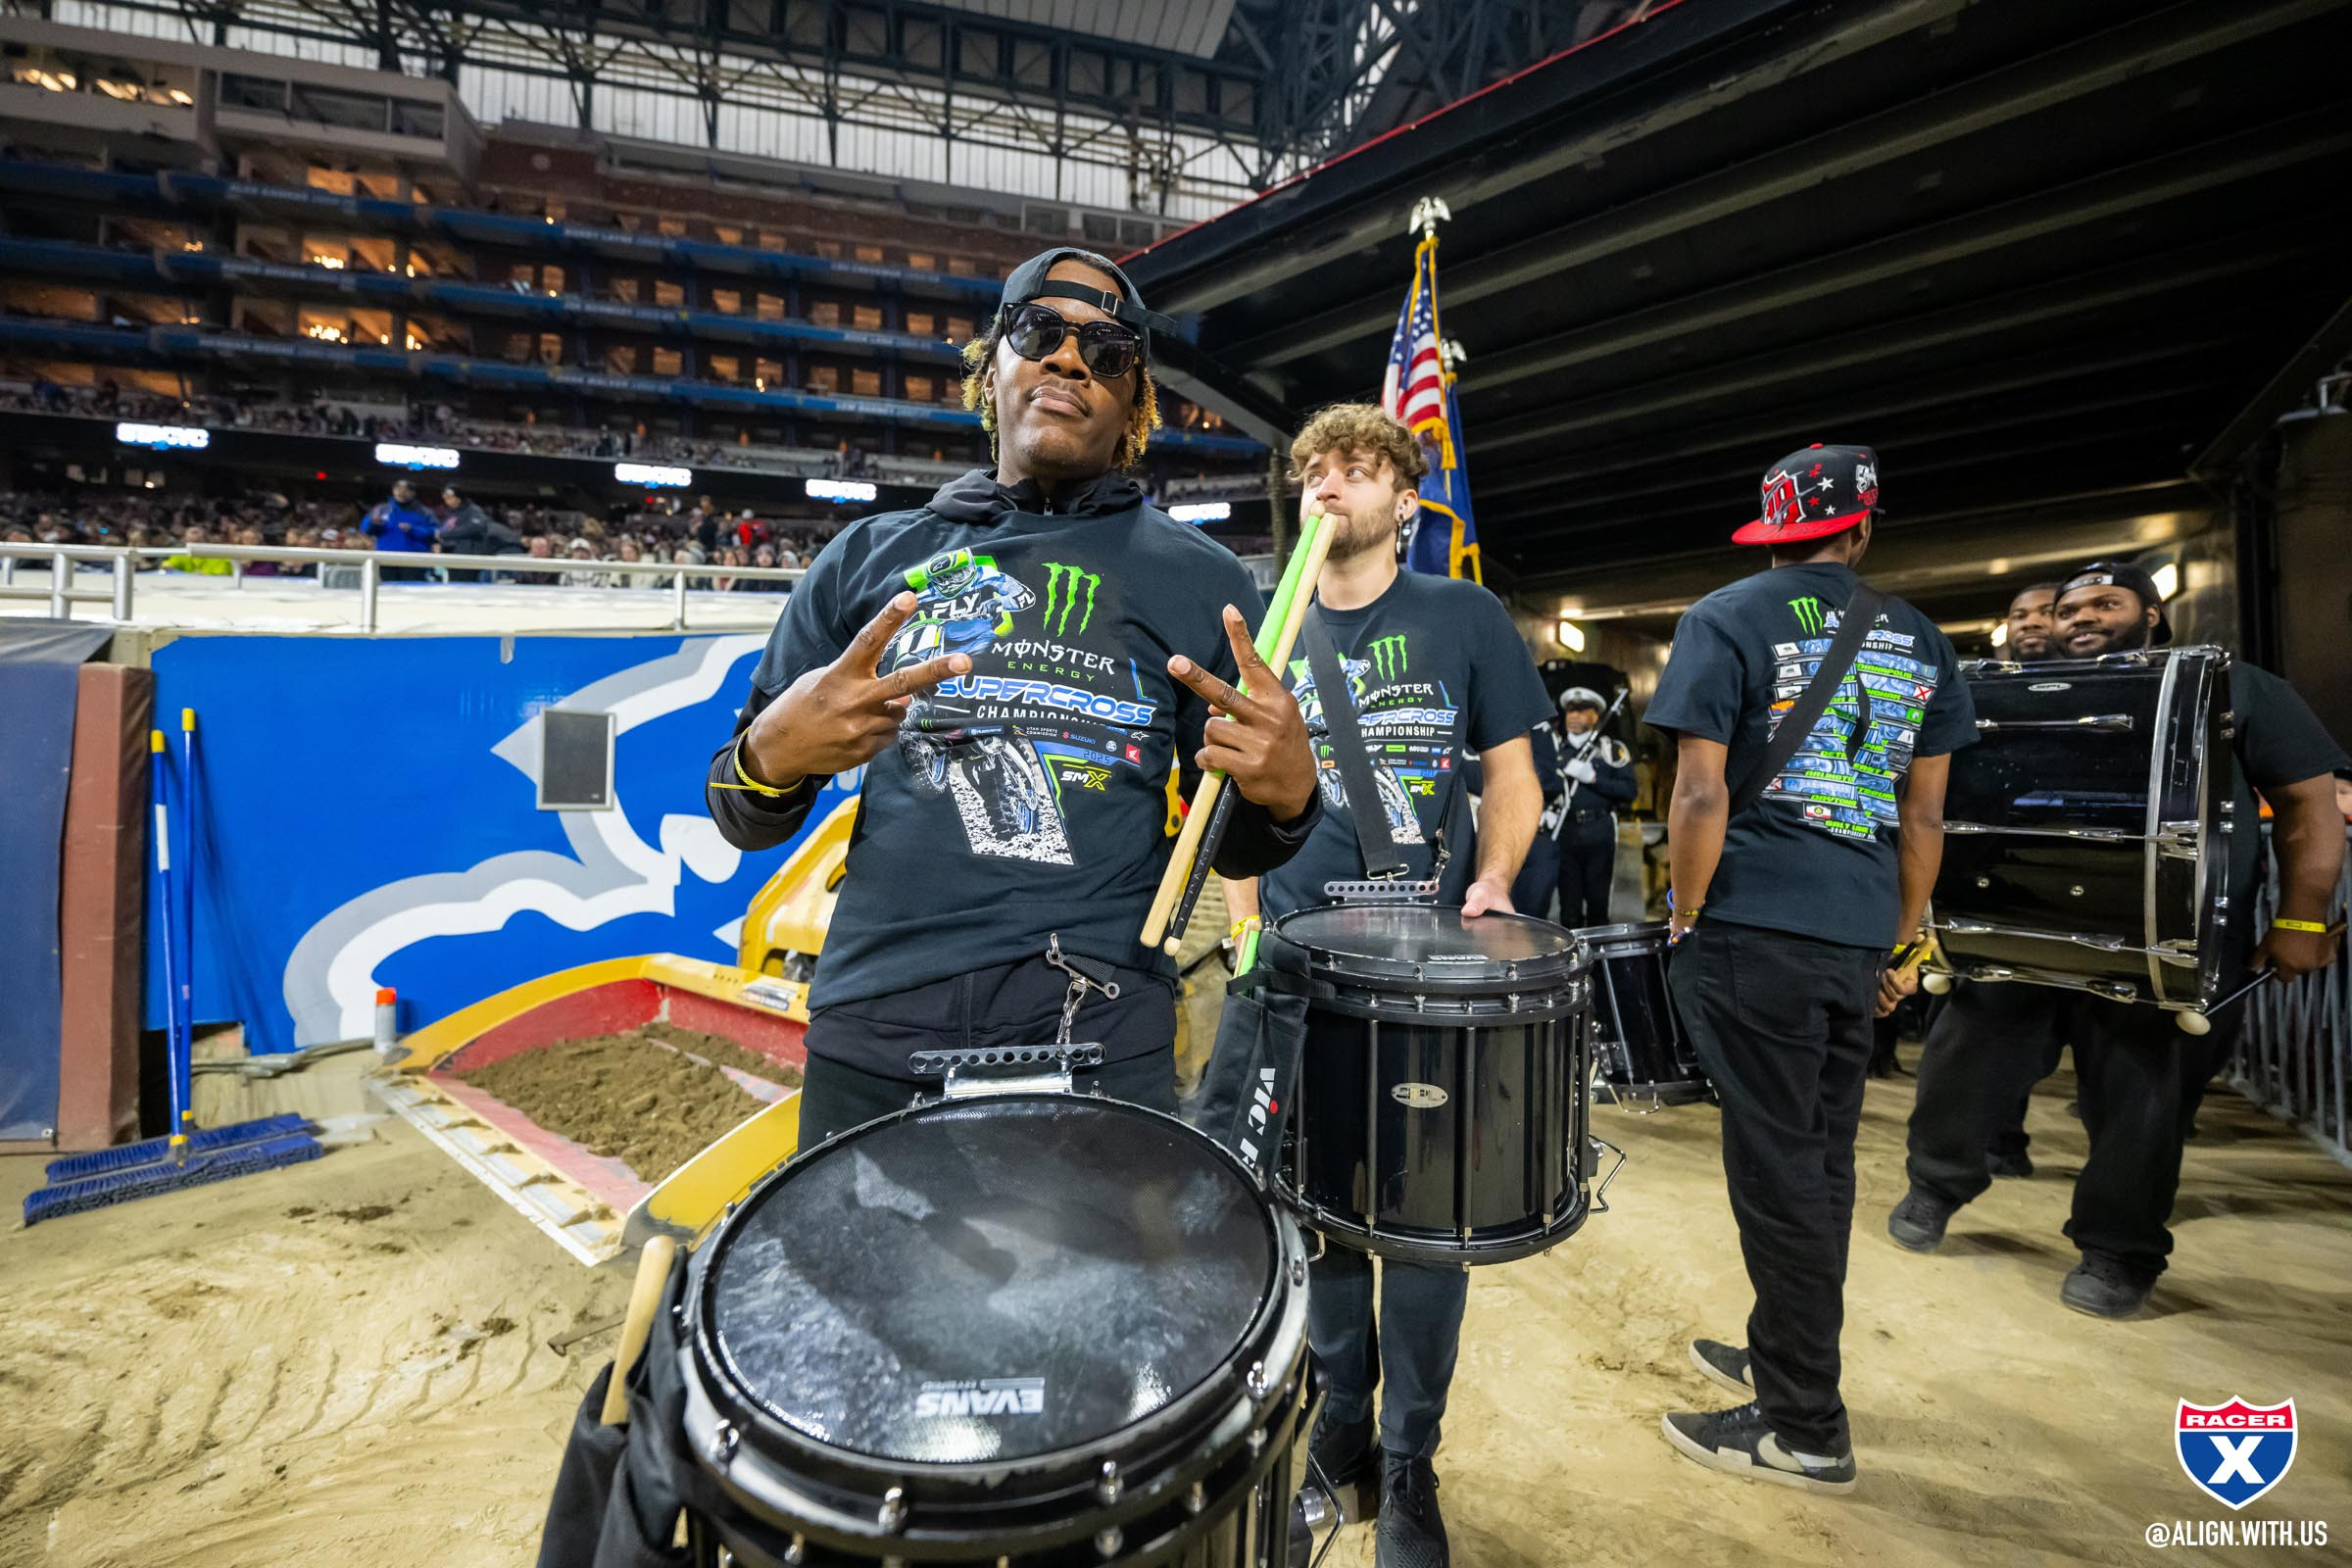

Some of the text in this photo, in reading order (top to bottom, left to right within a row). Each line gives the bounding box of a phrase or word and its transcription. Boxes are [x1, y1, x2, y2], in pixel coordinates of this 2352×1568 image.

[931, 593, 979, 619] FLY
[1007, 661, 1095, 682] ENERGY
[1361, 726, 1435, 738] HAMPIONSHIP
[1083, 749, 1110, 764] 2025
[1060, 769, 1112, 791] SMX
[914, 1389, 1045, 1418] EVANS
